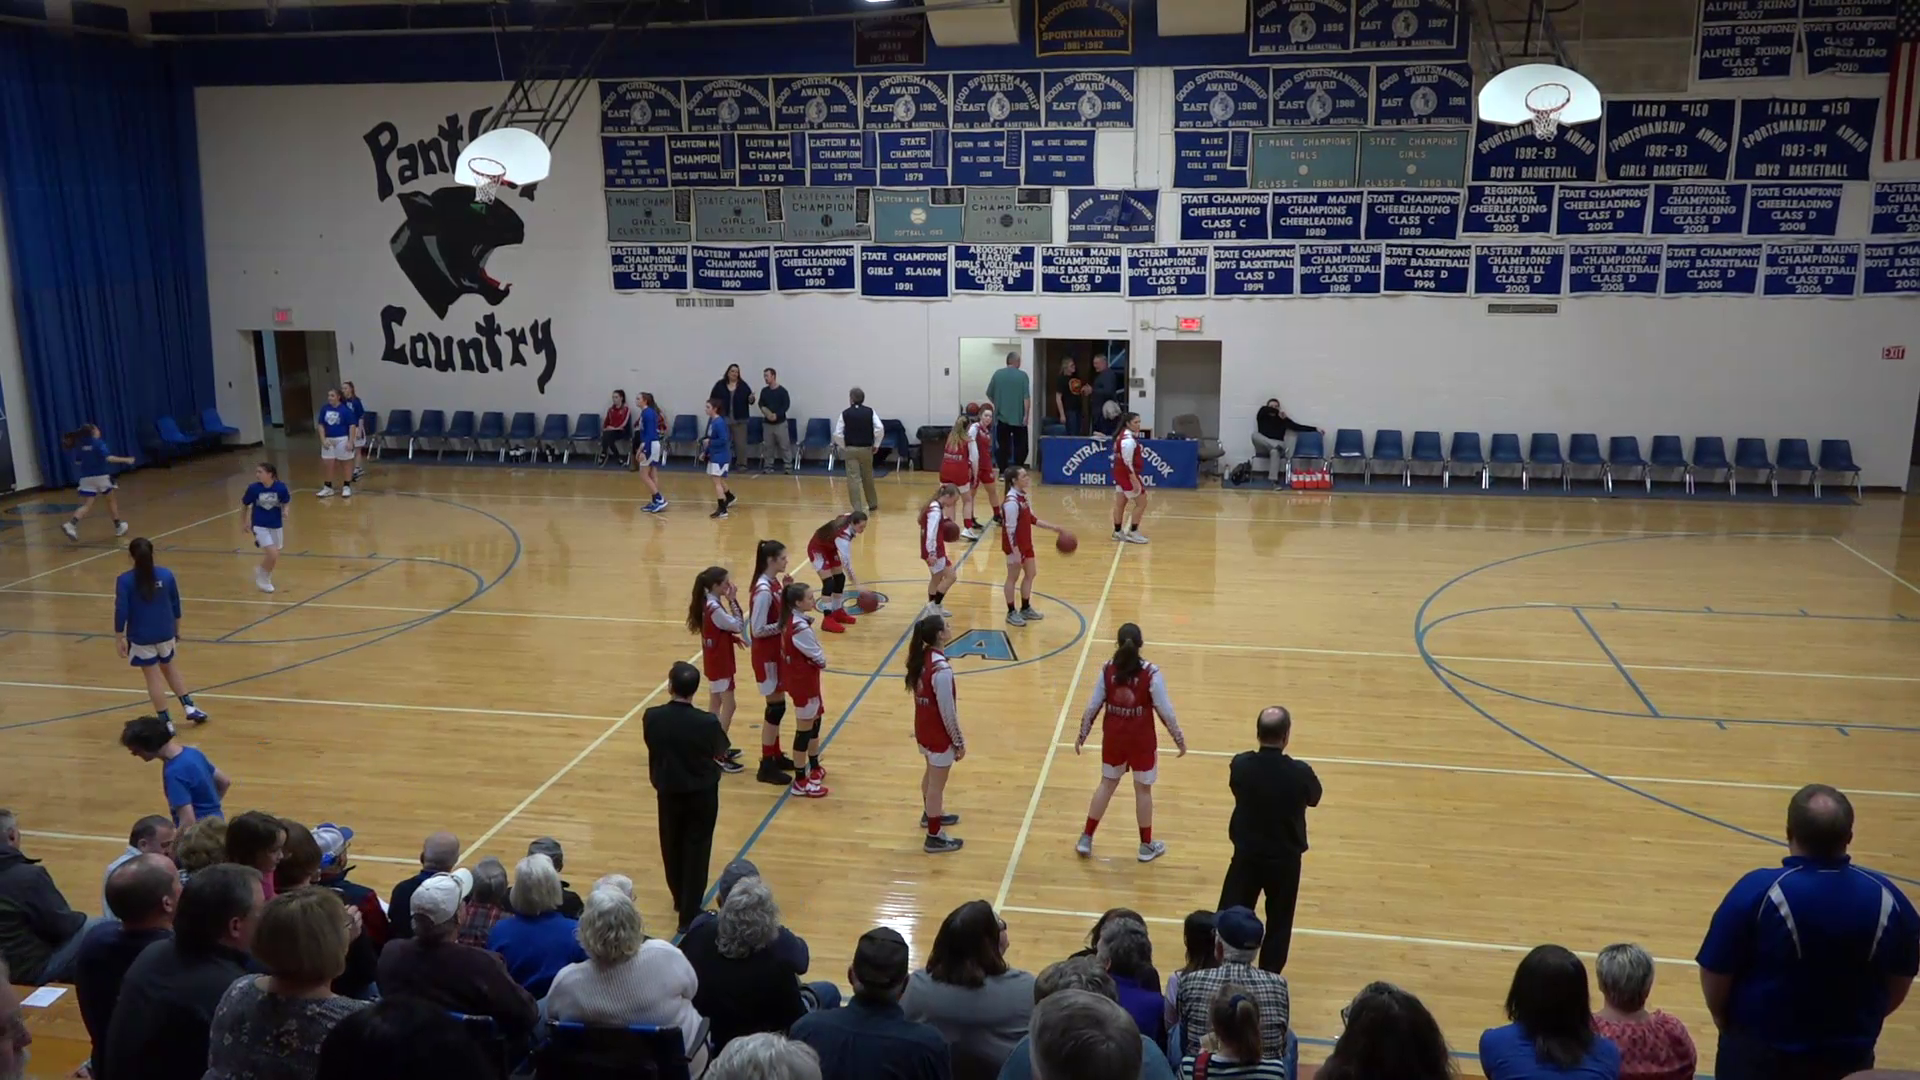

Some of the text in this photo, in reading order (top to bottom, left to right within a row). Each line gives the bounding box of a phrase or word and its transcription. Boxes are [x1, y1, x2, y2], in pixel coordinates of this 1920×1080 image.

[1288, 3, 1316, 11] AWARD
[1706, 0, 1797, 11] ALPINE SKIING
[1736, 10, 1764, 19] 2007
[1836, 7, 1862, 16] 2010
[1259, 24, 1282, 34] EAST
[1360, 21, 1381, 30] EAST
[1803, 23, 1832, 32] STATE
[1042, 29, 1125, 40] SPORTSMANSHIP
[1702, 25, 1797, 36] STATE CHAMPIONS
[1735, 36, 1760, 46] BOYS
[1823, 37, 1854, 47] CLASS
[1702, 46, 1791, 59] ALPINE SKIING
[1721, 58, 1755, 68] CLASS
[1404, 65, 1469, 88] SPORTSMANSHIP
[1731, 67, 1758, 77] 2008
[1293, 68, 1368, 98] SPORTSMANSHIP
[1410, 75, 1438, 84] AWARD
[980, 83, 1014, 91] AWARD
[1063, 72, 1134, 102] SPORTSMANSHIP
[1073, 82, 1104, 91] AWARD
[1176, 70, 1267, 102] GOOD SPORTSMANSHIP
[1205, 82, 1238, 91] AWARD
[1304, 80, 1337, 90] AWARD
[712, 89, 742, 98] AWARD
[791, 76, 858, 106] SPORTSMANSHIP
[800, 87, 831, 97] AWARD
[879, 75, 948, 106] SPORTSMANSHIP
[889, 86, 920, 95] AWARD
[967, 73, 1040, 110] SPORTSMANSHIP
[625, 91, 655, 100] AWARD
[962, 103, 986, 111] EAST
[1052, 102, 1077, 110] EAST
[1182, 103, 1209, 111] EAST
[1278, 101, 1305, 109] EAST
[1381, 98, 1403, 107] EAST
[607, 109, 630, 117] EAST
[694, 108, 717, 116] EAST
[781, 105, 805, 114] EAST
[870, 105, 894, 113] EAST
[1632, 103, 1666, 117] IAABO
[1768, 102, 1807, 116] IAABO
[1609, 121, 1728, 153] SPORTSMANSHIP AWARD
[1742, 119, 1869, 152] SPORTSMANSHIP AWARD
[670, 140, 701, 148] EASTERN
[745, 139, 775, 148] EASTERN
[810, 139, 847, 147] EASTERN
[900, 137, 926, 146] STATE
[1201, 137, 1223, 145] MAINE
[1269, 137, 1352, 147] MAINE CHAMPIONS
[1370, 137, 1458, 146] STATE CHAMPIONS
[1563, 129, 1596, 155] AWARD
[1399, 150, 1426, 158] GIRLS
[1515, 146, 1557, 159] 1992-93
[1644, 144, 1688, 157] 1992-93
[1780, 143, 1828, 157] 1993-94
[1290, 151, 1317, 159] GIRLS
[1490, 166, 1577, 179] BOYS BASKETBALL
[1619, 163, 1708, 177] GIRLS BASKETBALL
[1755, 164, 1848, 177] BOYS BASKETBALL
[1484, 186, 1535, 195] REGIONAL
[1589, 188, 1649, 198] CHAMPIONS
[1672, 186, 1727, 195] REGIONAL
[1182, 194, 1268, 204] STATE CHAMPIONS
[1274, 195, 1361, 204] EASTERN MAINE
[1367, 194, 1460, 204] STATE CHAMPIONS
[1481, 196, 1537, 205] CHAMPION
[1667, 196, 1731, 205] CHAMPIONS
[1469, 204, 1548, 213] CHEERLEADING
[1564, 199, 1641, 210] CHEERLEADING
[1757, 200, 1834, 209] CHEERLEADING
[1188, 206, 1261, 216] CHEERLEADING
[1288, 205, 1347, 215] CHAMPIONS
[1374, 205, 1451, 215] CHEERLEADING
[1659, 205, 1737, 215] CHEERLEADING
[1484, 214, 1516, 223] CLASS
[1578, 211, 1610, 220] CLASS
[1673, 215, 1706, 224] CLASS
[1771, 211, 1803, 220] CLASS
[632, 218, 666, 226] GIRLS
[1201, 219, 1231, 228] CLASS
[1280, 216, 1353, 226] CHEERLEADING
[1387, 216, 1420, 225] CLASS
[1493, 224, 1519, 232] 2002
[1587, 222, 1614, 231] 2002
[1213, 230, 1236, 239] 1988
[1305, 228, 1327, 236] 1989
[1399, 227, 1422, 236] 1989
[1530, 247, 1564, 255] MAINE
[1667, 247, 1760, 257] STATE CHAMPIONS
[862, 252, 947, 261] STATE CHAMPIONS
[1311, 255, 1371, 264] CHAMPIONS
[1487, 256, 1552, 265] CHAMPIONS
[1582, 255, 1648, 264] CHAMPIONS
[1778, 255, 1845, 264] CHAMPIONS
[705, 260, 757, 269] CHAMPIONS
[781, 258, 847, 267] CHEERLEADING
[983, 261, 1034, 269] VOLLEYBALL
[1053, 257, 1109, 266] CHAMPIONS
[1140, 257, 1196, 267] CHAMPIONS
[1240, 259, 1294, 269] BASKETBALL
[1695, 259, 1759, 268] BASKETBALL
[794, 268, 822, 277] CLASS
[867, 267, 941, 276] GIRLS SLALOM
[1067, 265, 1120, 274] BASKETBALL
[1404, 269, 1435, 278] CLASS
[1492, 265, 1545, 274] BASEBALL
[1601, 265, 1659, 273] BASKETBALL
[1686, 269, 1720, 278] CLASS
[1795, 266, 1856, 275] BASKETBALL
[698, 270, 764, 279] CHEERLEADING
[1059, 275, 1088, 283] CLASS
[1234, 271, 1264, 280] CLASS
[1320, 275, 1348, 283] CLASS
[1591, 274, 1623, 283] CLASS
[721, 280, 741, 288] 1990
[805, 278, 826, 286] 1990
[1147, 277, 1175, 285] CLASS
[1414, 280, 1435, 288] 1996
[1495, 275, 1527, 284] CLASS
[1785, 275, 1819, 284] CLASS
[895, 282, 913, 290] 1991
[1071, 283, 1091, 291] 1993
[1157, 286, 1177, 294] 1994
[1243, 282, 1264, 291] 1994
[1505, 285, 1530, 293] 2003
[380, 304, 557, 394] Country
[1062, 440, 1107, 476] CENTRAL
[1080, 473, 1106, 485] HIGH
